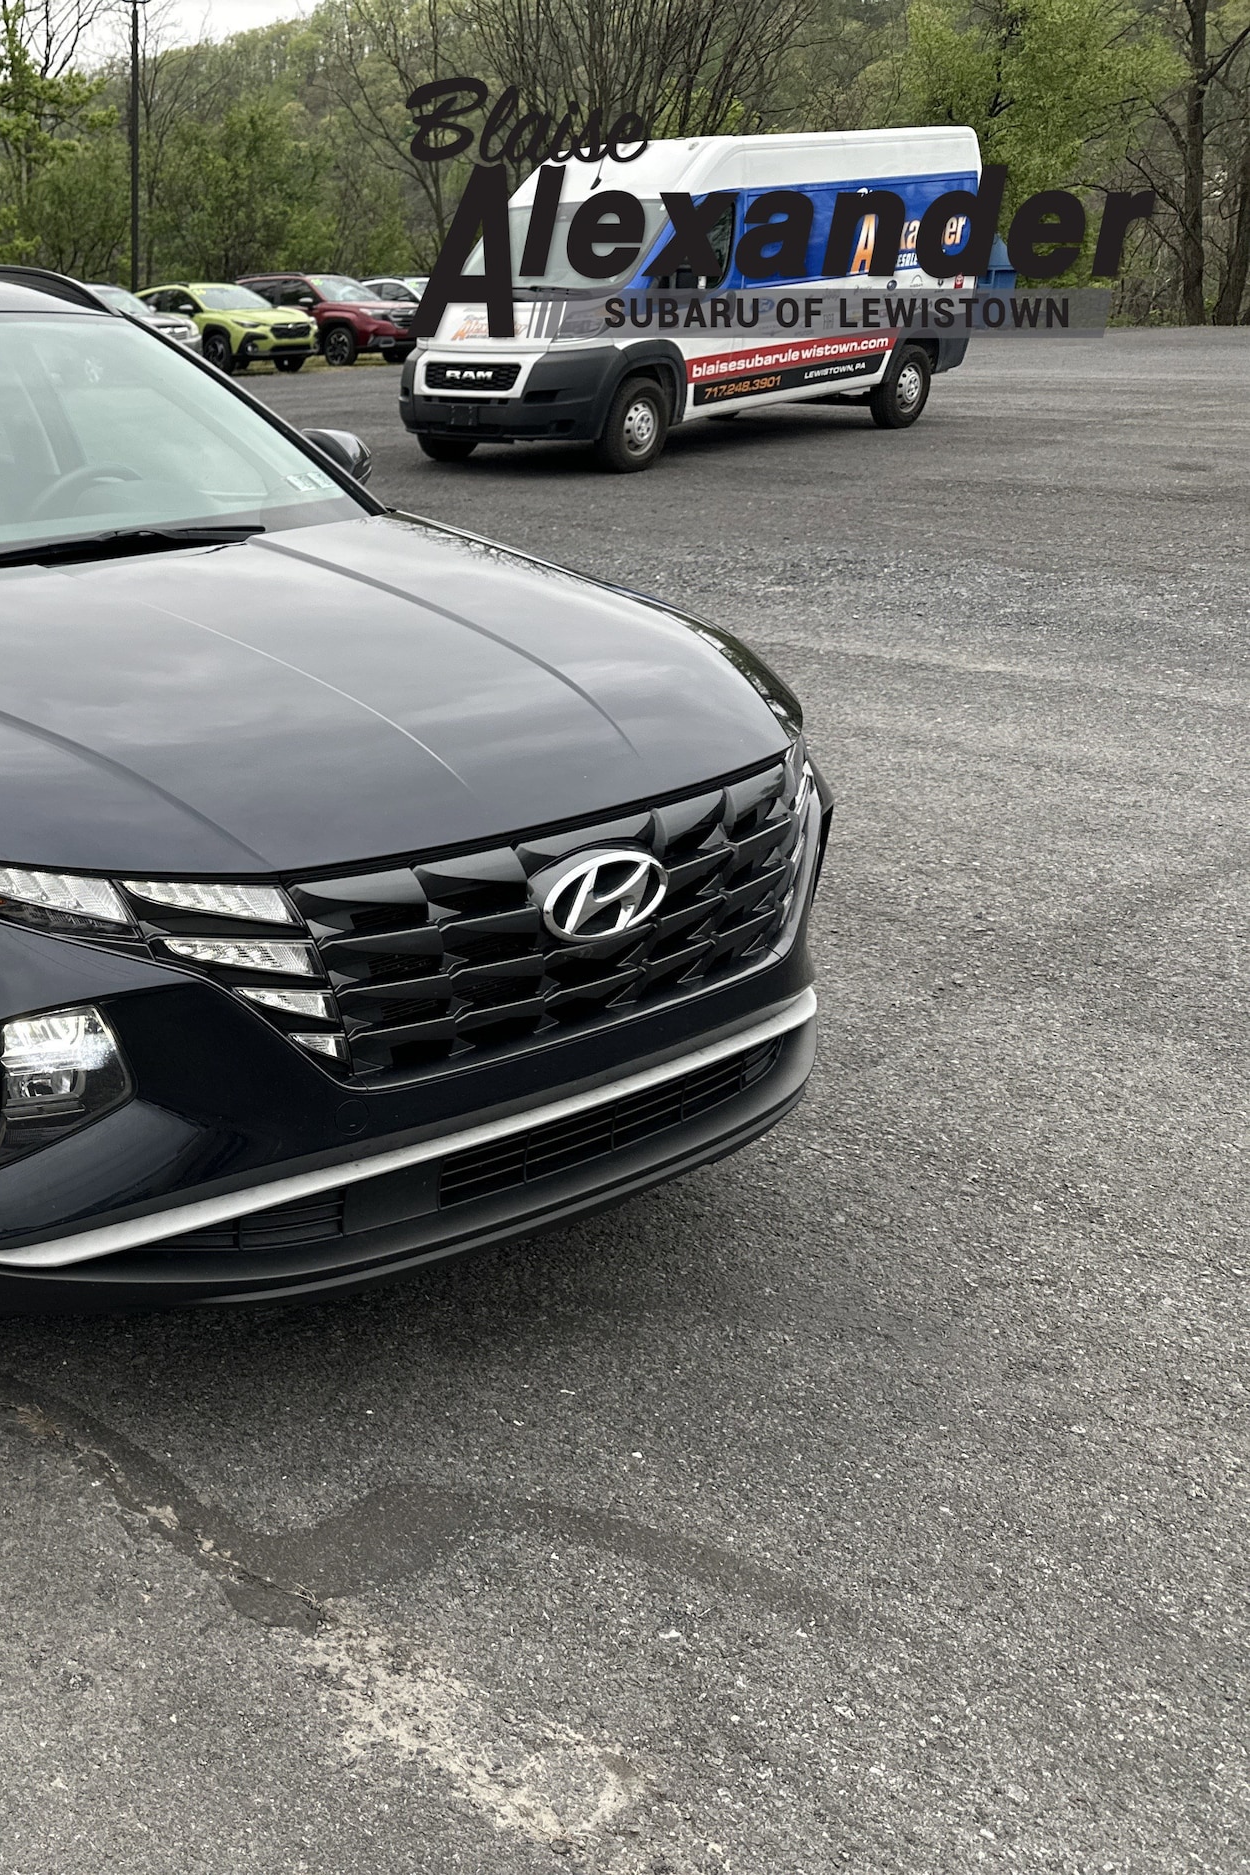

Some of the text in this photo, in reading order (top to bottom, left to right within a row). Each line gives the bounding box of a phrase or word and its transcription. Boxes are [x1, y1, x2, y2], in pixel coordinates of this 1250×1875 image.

[445, 370, 494, 380] RAM
[704, 361, 866, 399] 717.248.3901 LEWISTOWN, PA
